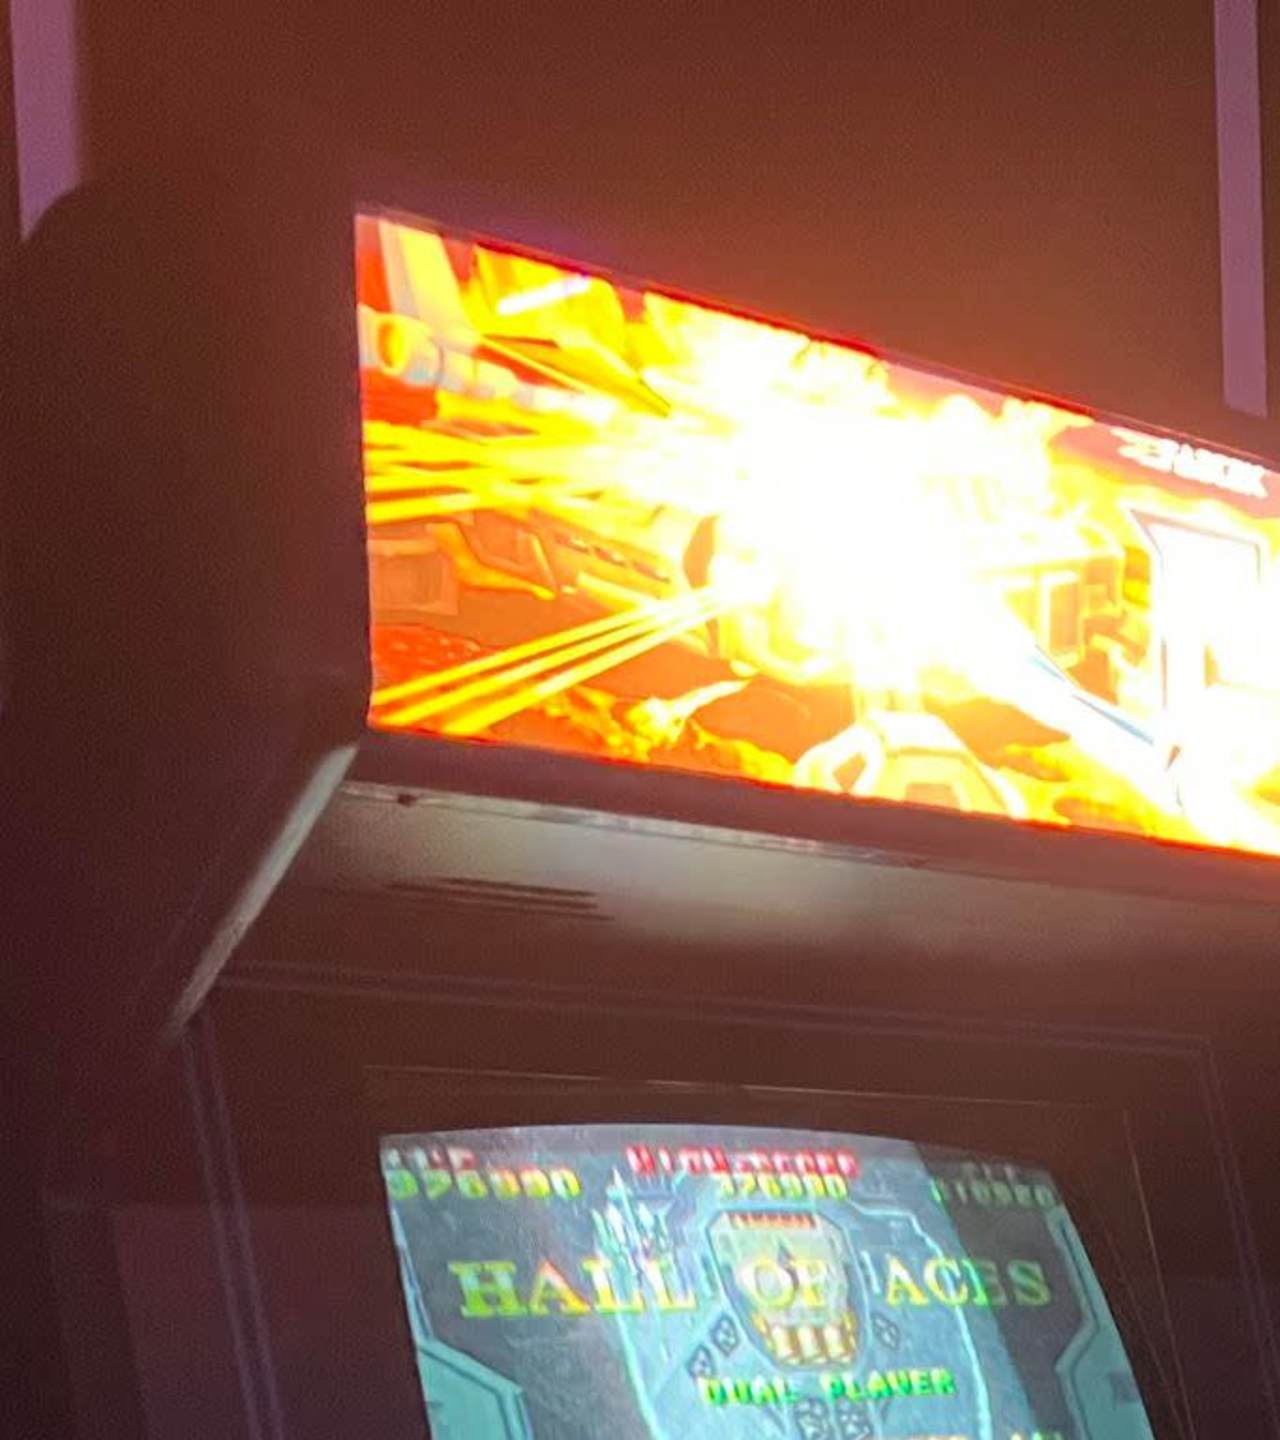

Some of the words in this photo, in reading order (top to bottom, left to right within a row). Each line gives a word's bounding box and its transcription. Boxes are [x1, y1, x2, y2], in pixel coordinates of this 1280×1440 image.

[448, 1259, 697, 1318] HALL
[734, 1253, 835, 1312] OF
[883, 1257, 1053, 1309] ACES
[699, 1375, 797, 1406] DUAL
[820, 1368, 958, 1402] PLAYER
